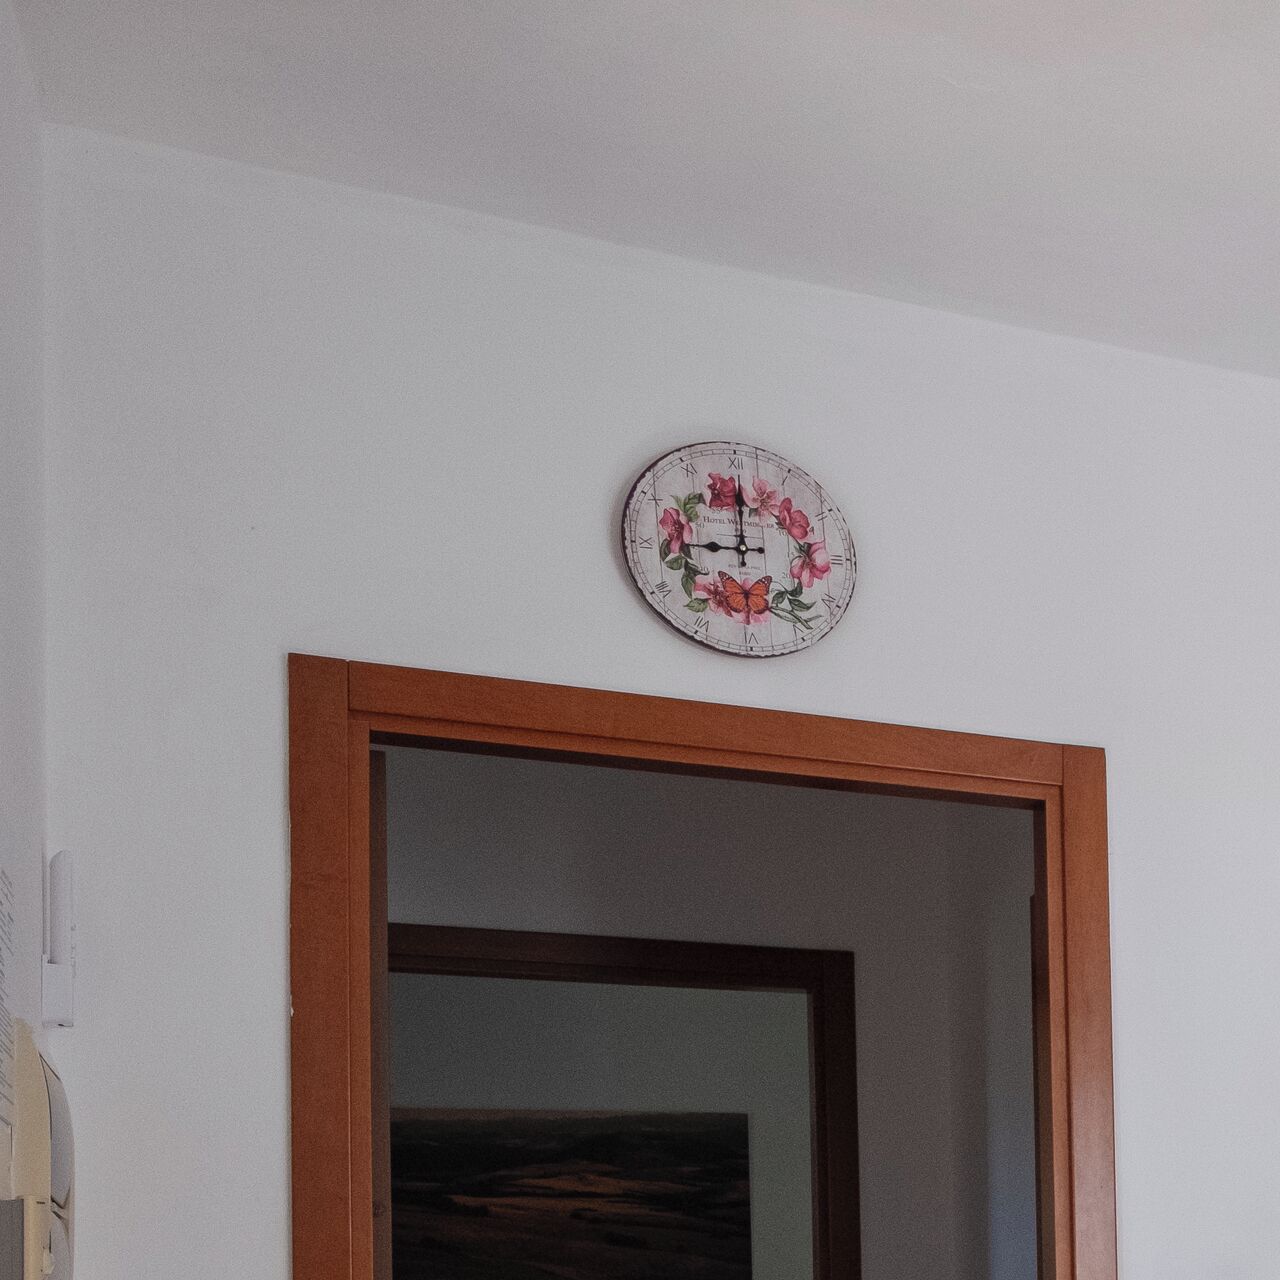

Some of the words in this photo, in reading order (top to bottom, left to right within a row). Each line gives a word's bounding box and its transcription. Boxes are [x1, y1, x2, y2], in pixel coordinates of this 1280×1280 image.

[681, 463, 697, 478] XI
[728, 457, 743, 470] XII
[648, 493, 663, 507] X
[728, 519, 774, 529] WETMINER
[639, 537, 653, 549] IX
[830, 555, 843, 565] III
[655, 581, 672, 598] VIII
[821, 593, 836, 608] IV
[694, 616, 709, 633] VII
